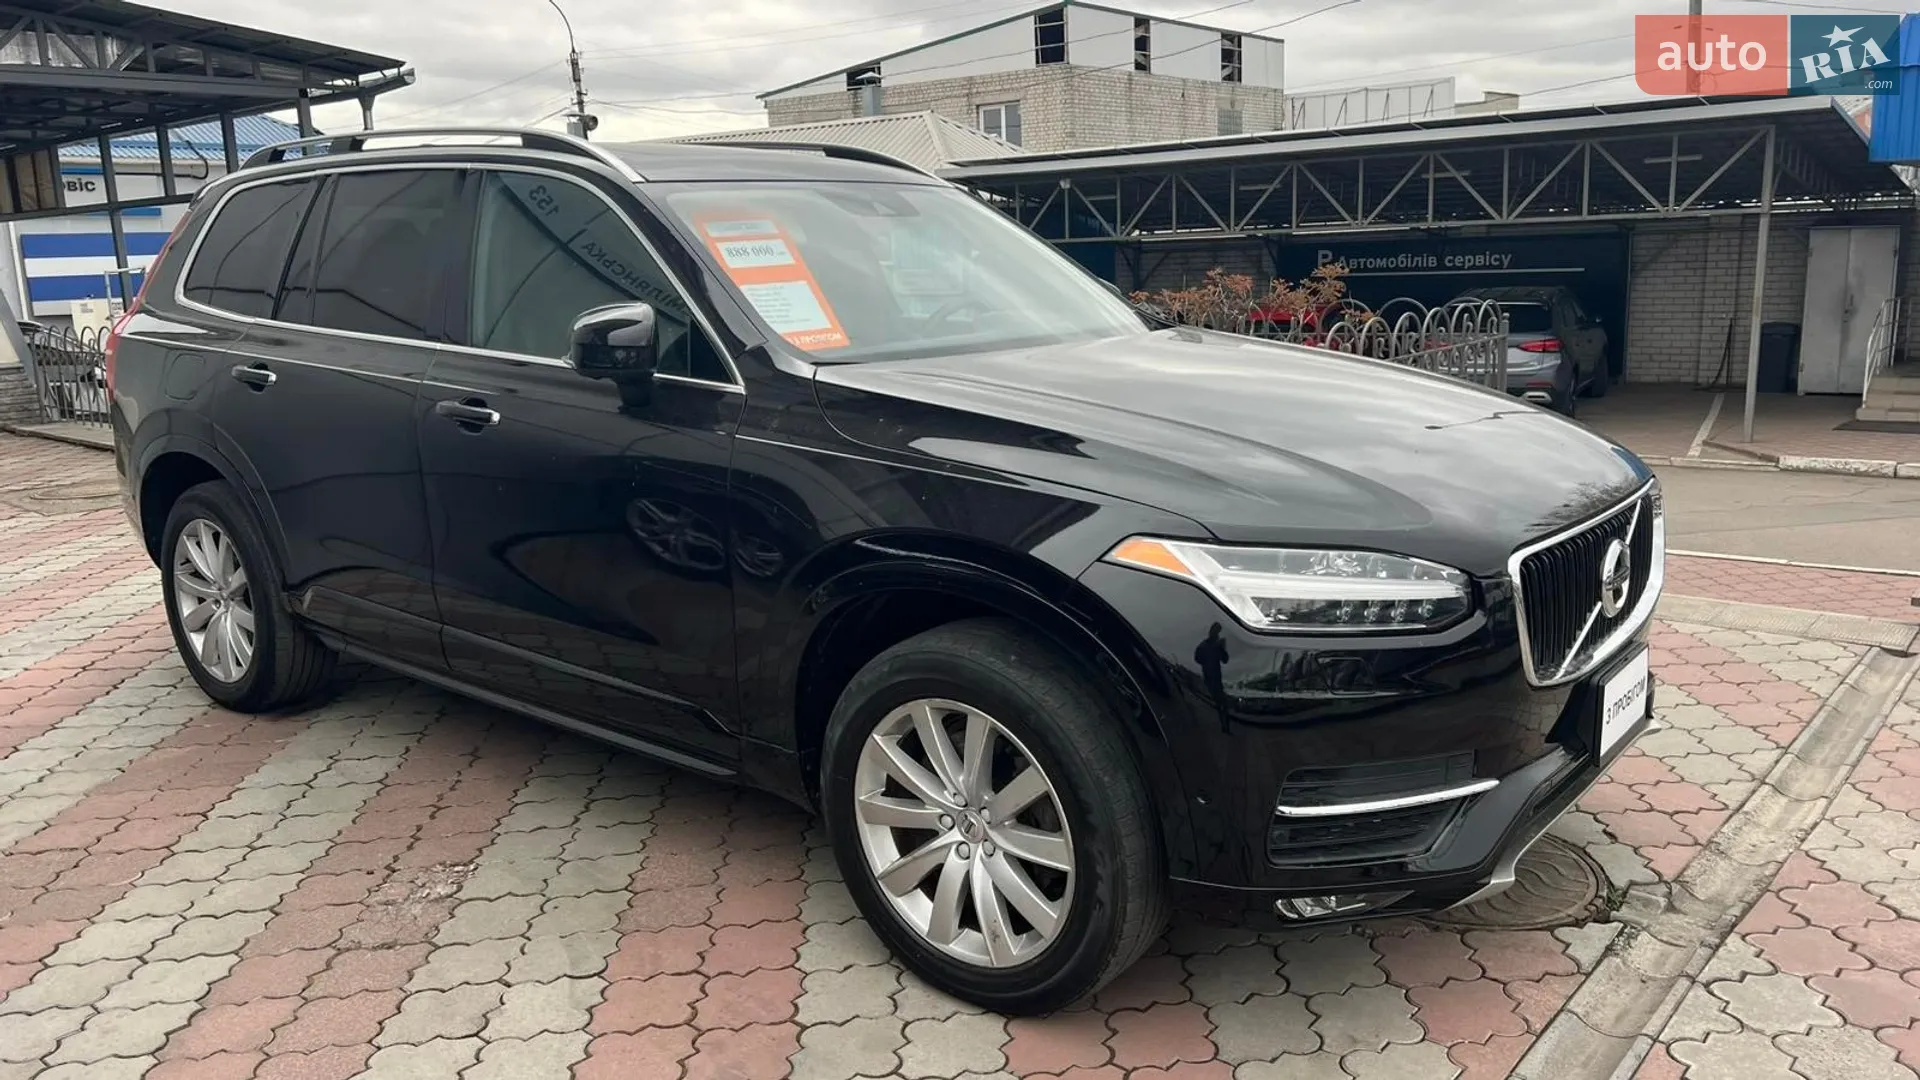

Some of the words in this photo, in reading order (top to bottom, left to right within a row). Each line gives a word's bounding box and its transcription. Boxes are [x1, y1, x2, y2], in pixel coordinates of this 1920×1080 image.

[62, 177, 96, 192] віс
[1338, 253, 1438, 270] Автомобілів
[1444, 251, 1512, 270] сервісу
[1611, 675, 1646, 721] ПРОБІГОМ
